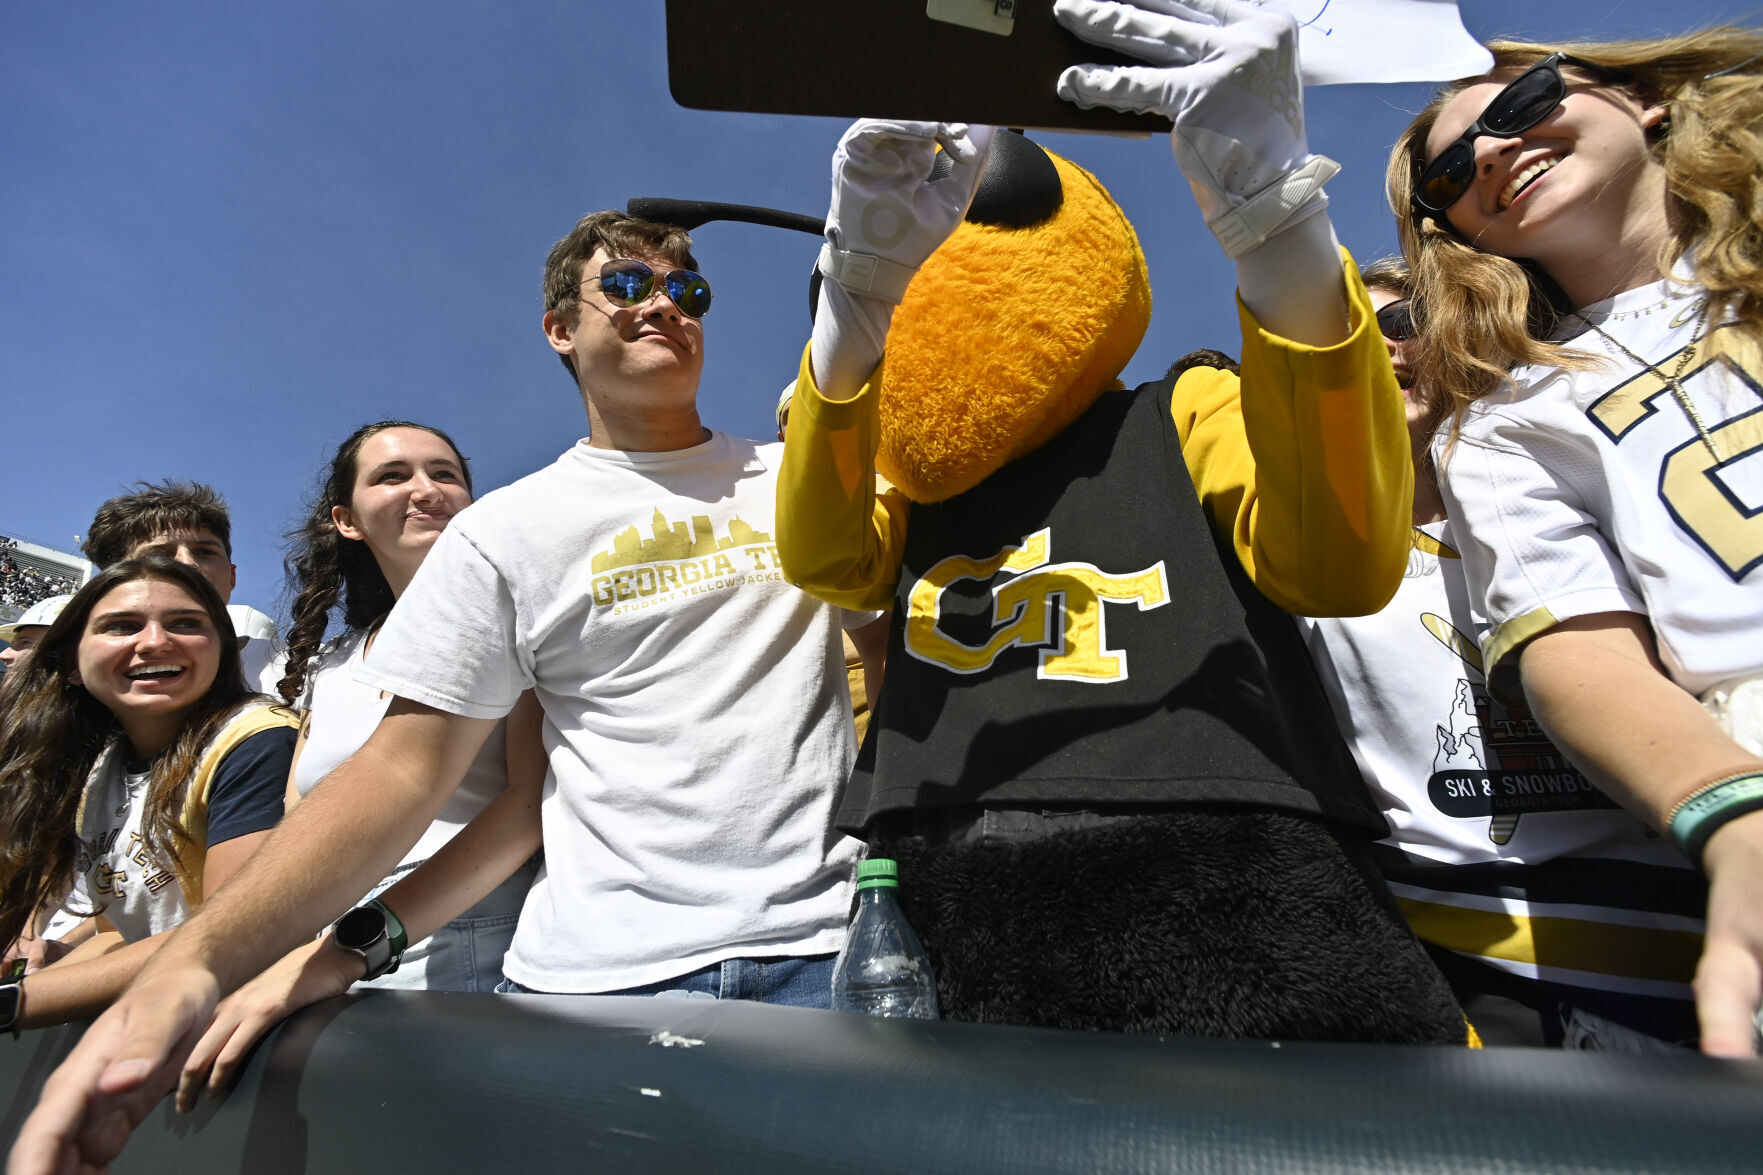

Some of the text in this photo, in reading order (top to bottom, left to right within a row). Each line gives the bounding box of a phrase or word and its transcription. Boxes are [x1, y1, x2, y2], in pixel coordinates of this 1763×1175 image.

[591, 546, 783, 607] GEORGIA TE
[614, 573, 781, 616] STUDENT YELLOW JACKE
[1497, 718, 1546, 738] TE
[1445, 773, 1593, 798] SKI & SNOWBO
[1495, 797, 1552, 808] GEORGIA
